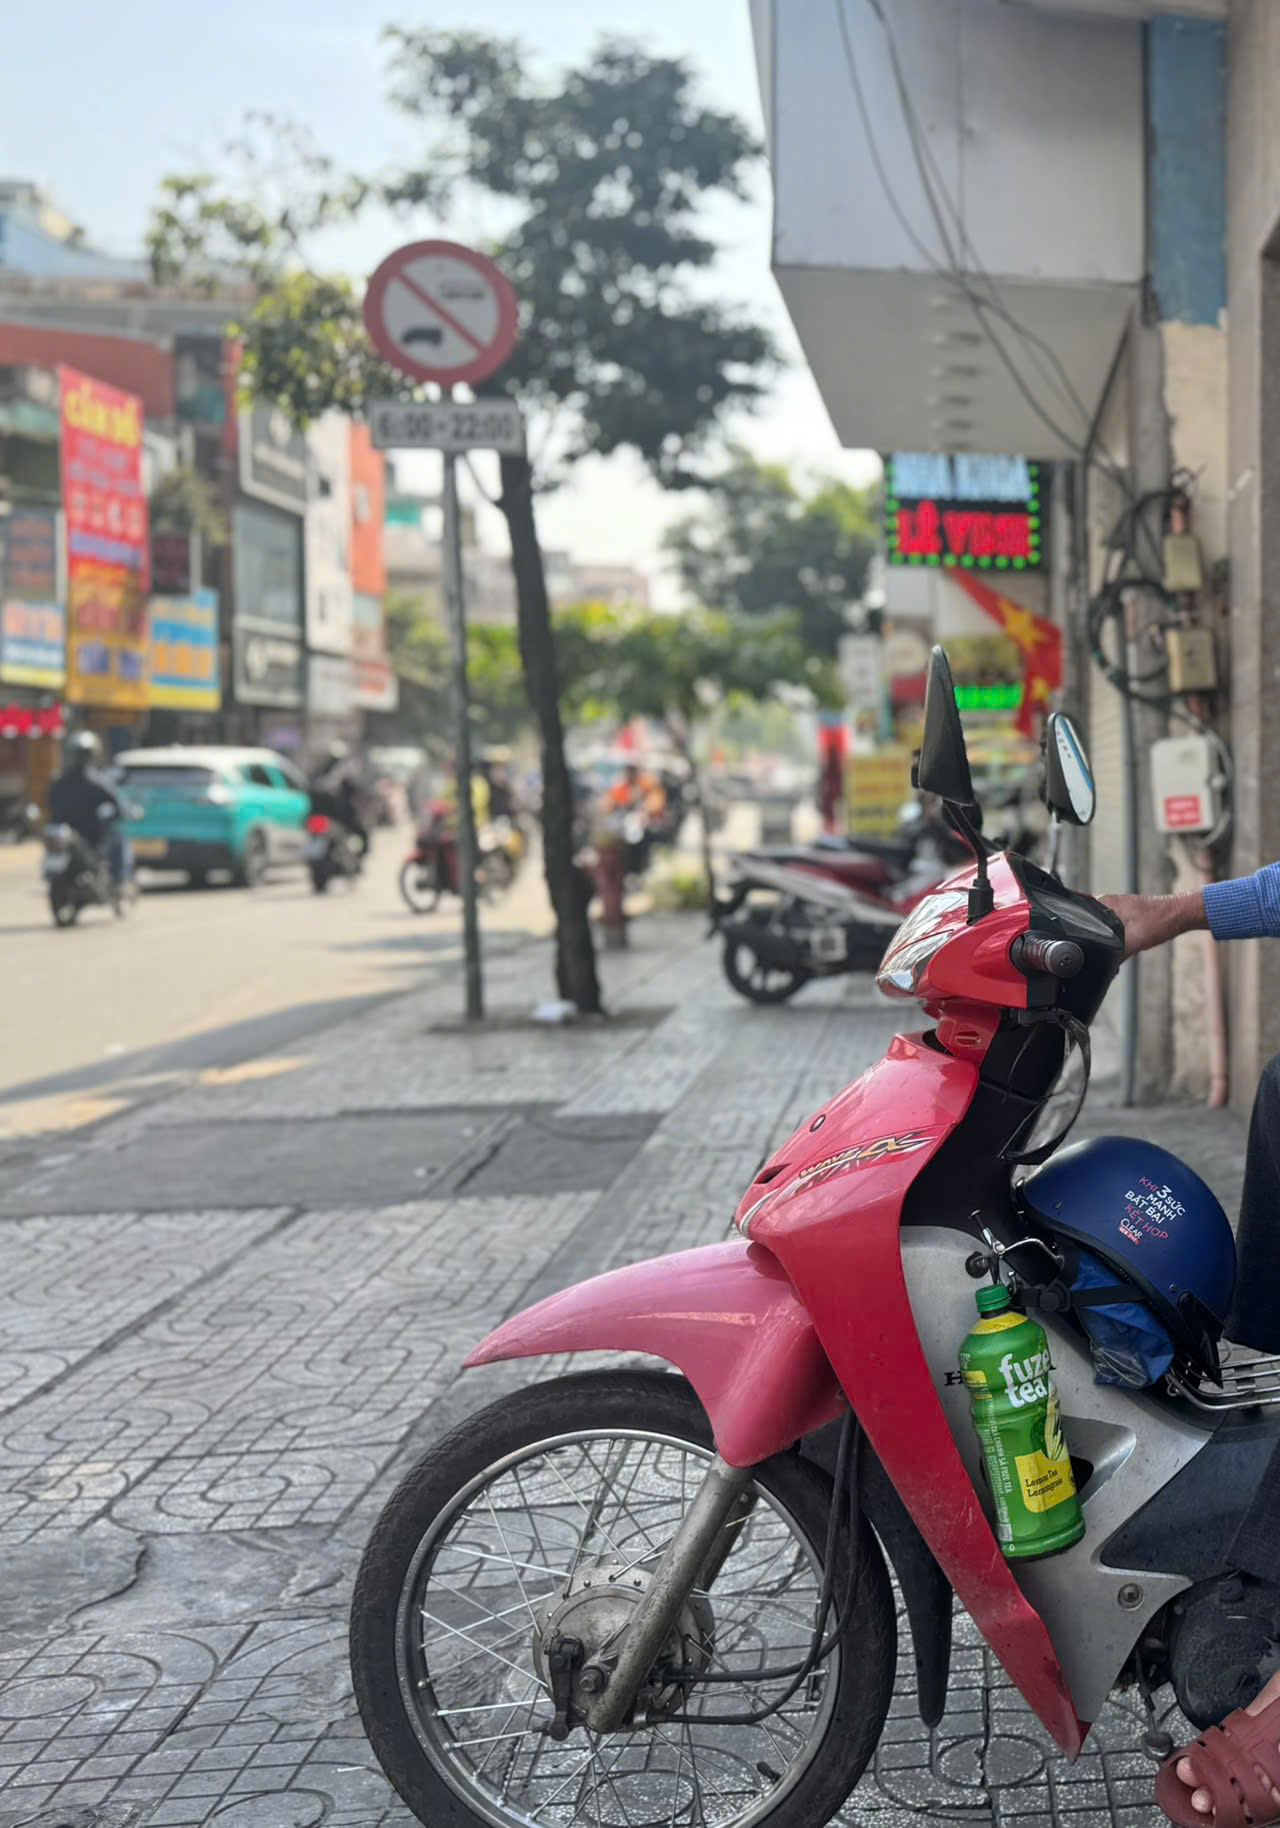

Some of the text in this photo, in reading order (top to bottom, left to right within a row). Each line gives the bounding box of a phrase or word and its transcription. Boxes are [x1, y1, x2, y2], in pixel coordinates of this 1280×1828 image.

[1124, 1190, 1165, 1224] BẤT BẠI
[1139, 1176, 1186, 1216] KHI 3 SỨC
[1146, 1193, 1177, 1220] MẠNH
[1120, 1218, 1143, 1238] CLEAR
[1125, 1203, 1145, 1225] KẾT
[999, 1349, 1051, 1385] fuze
[1004, 1378, 1048, 1408] tea
[1025, 1474, 1048, 1487] Lemon
